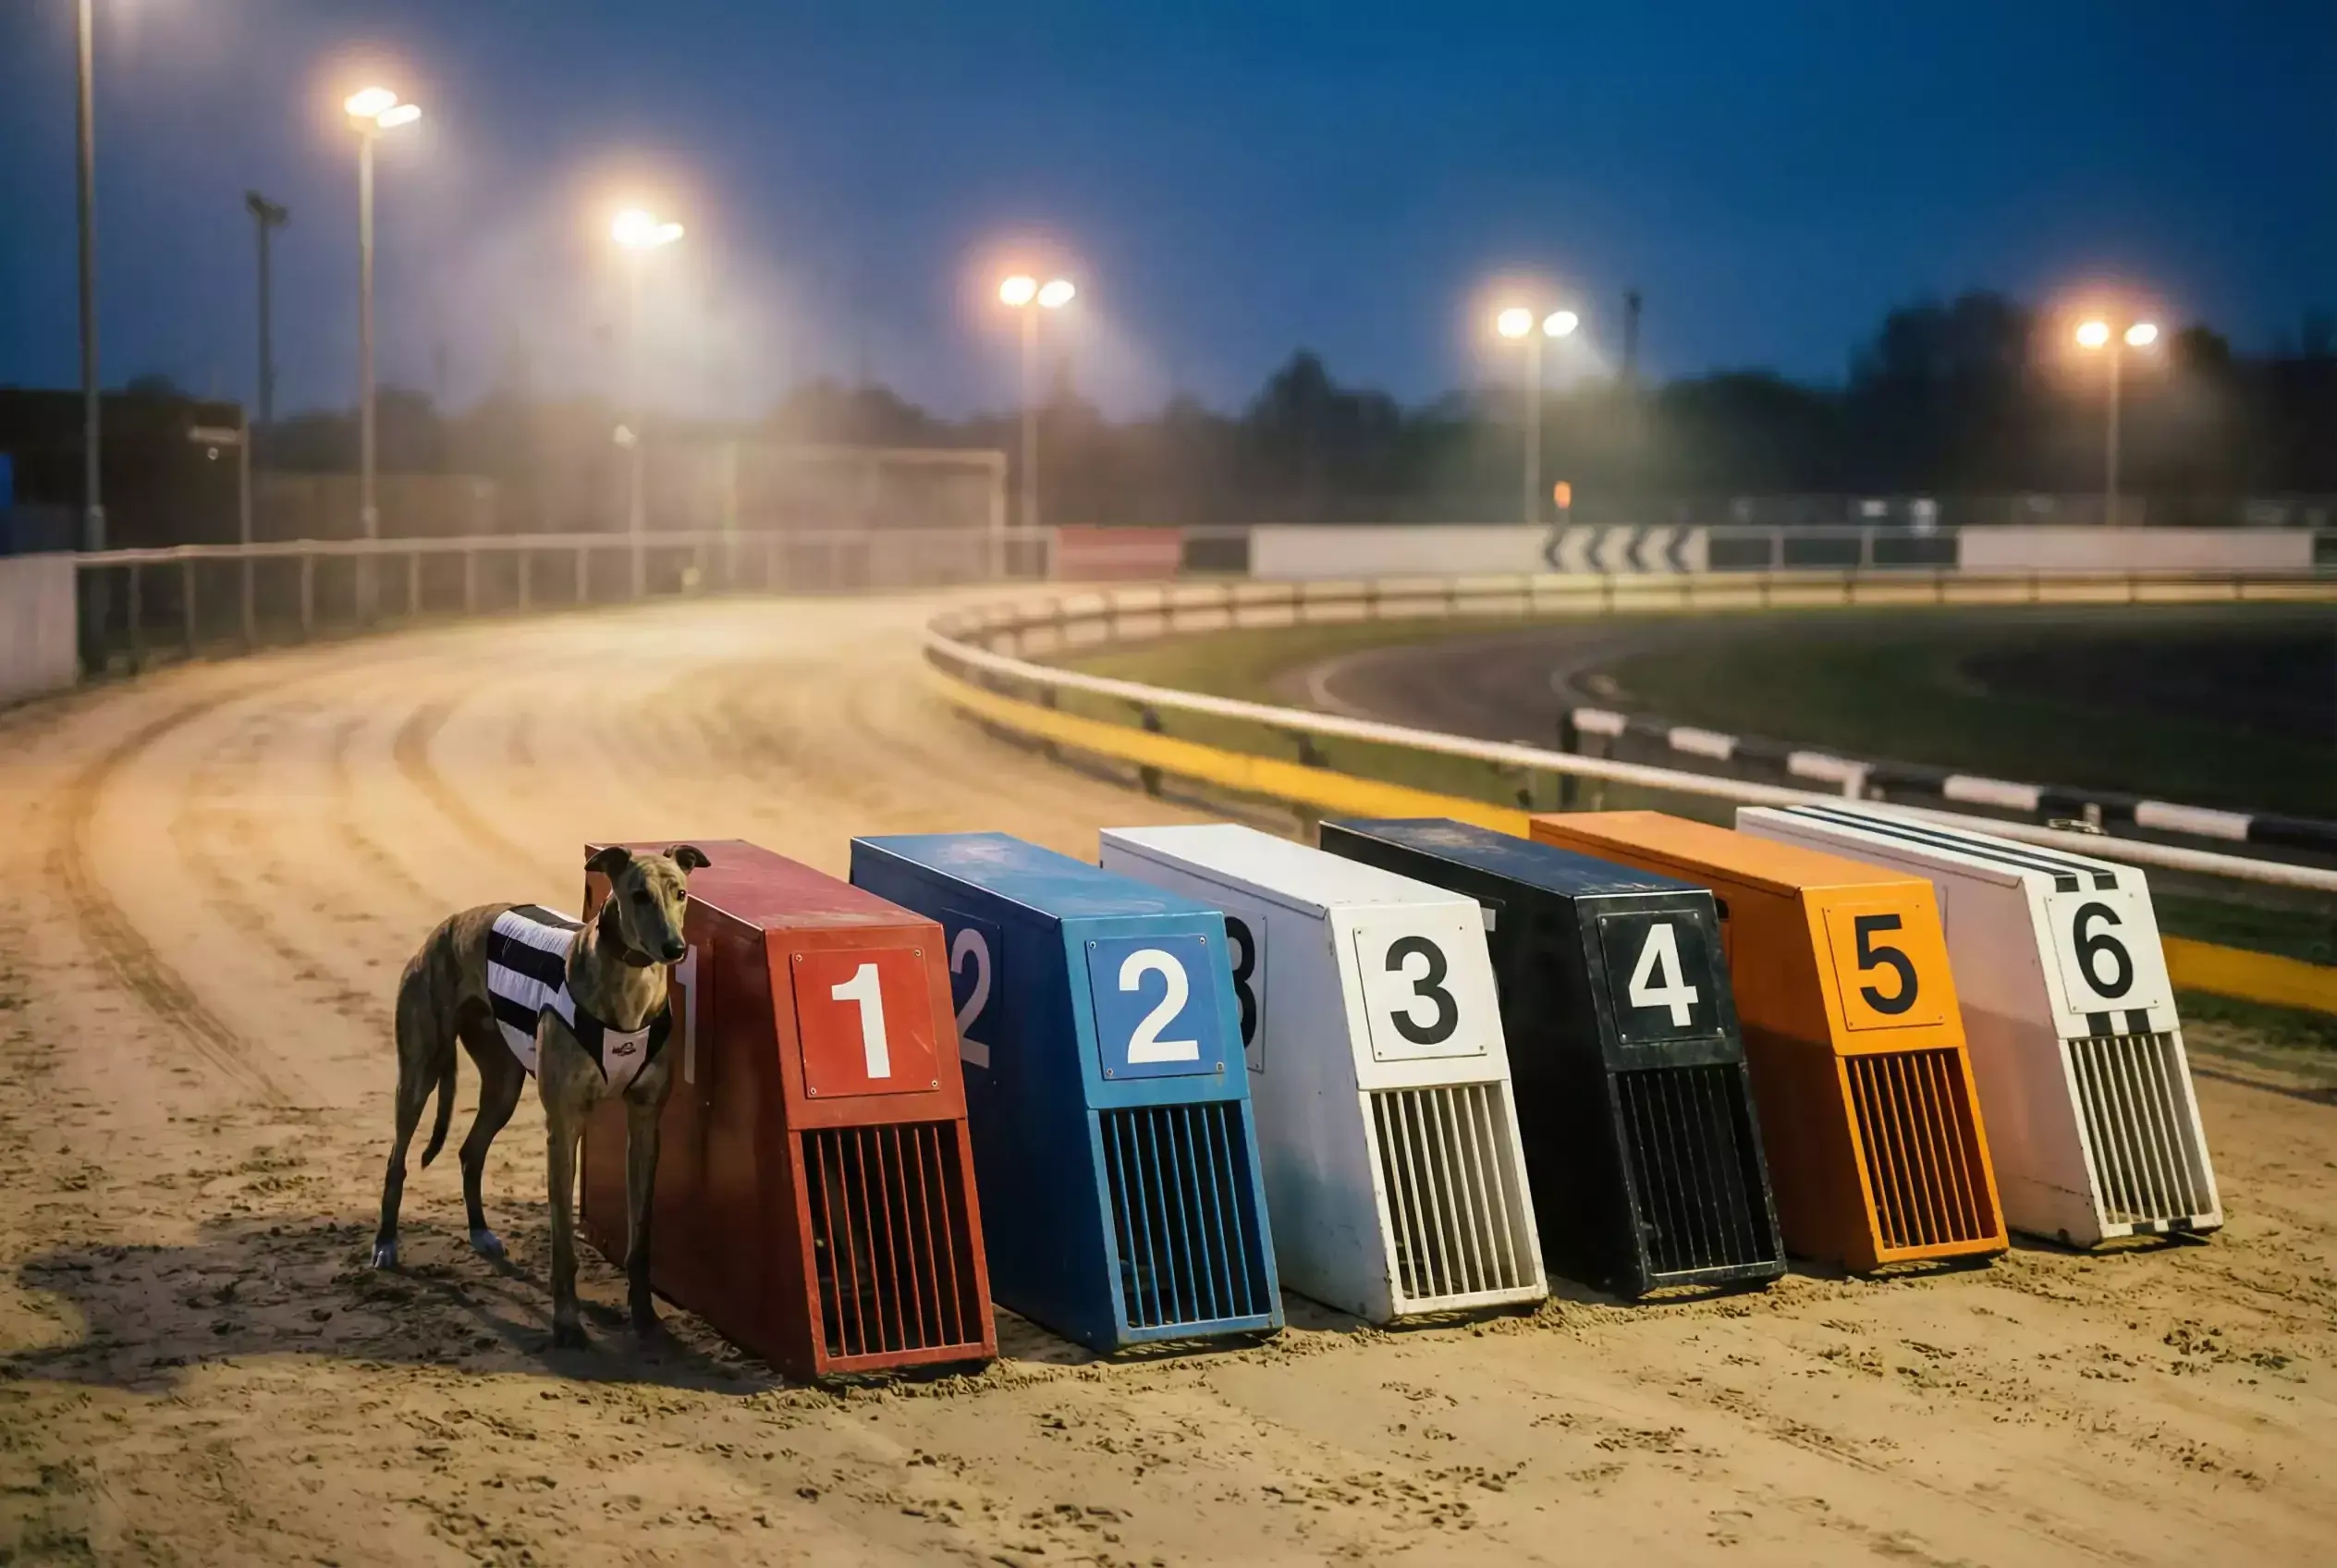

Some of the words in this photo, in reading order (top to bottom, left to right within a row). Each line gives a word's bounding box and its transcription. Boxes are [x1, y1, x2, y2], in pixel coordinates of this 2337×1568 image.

[950, 928, 991, 1069] 2
[1386, 936, 1459, 1045] 3
[1629, 923, 1698, 1027] 4
[1854, 913, 1918, 1014] 5
[2073, 901, 2134, 998] 6
[675, 943, 697, 1084] 1
[832, 962, 890, 1078] 1
[1119, 949, 1199, 1063] 2
